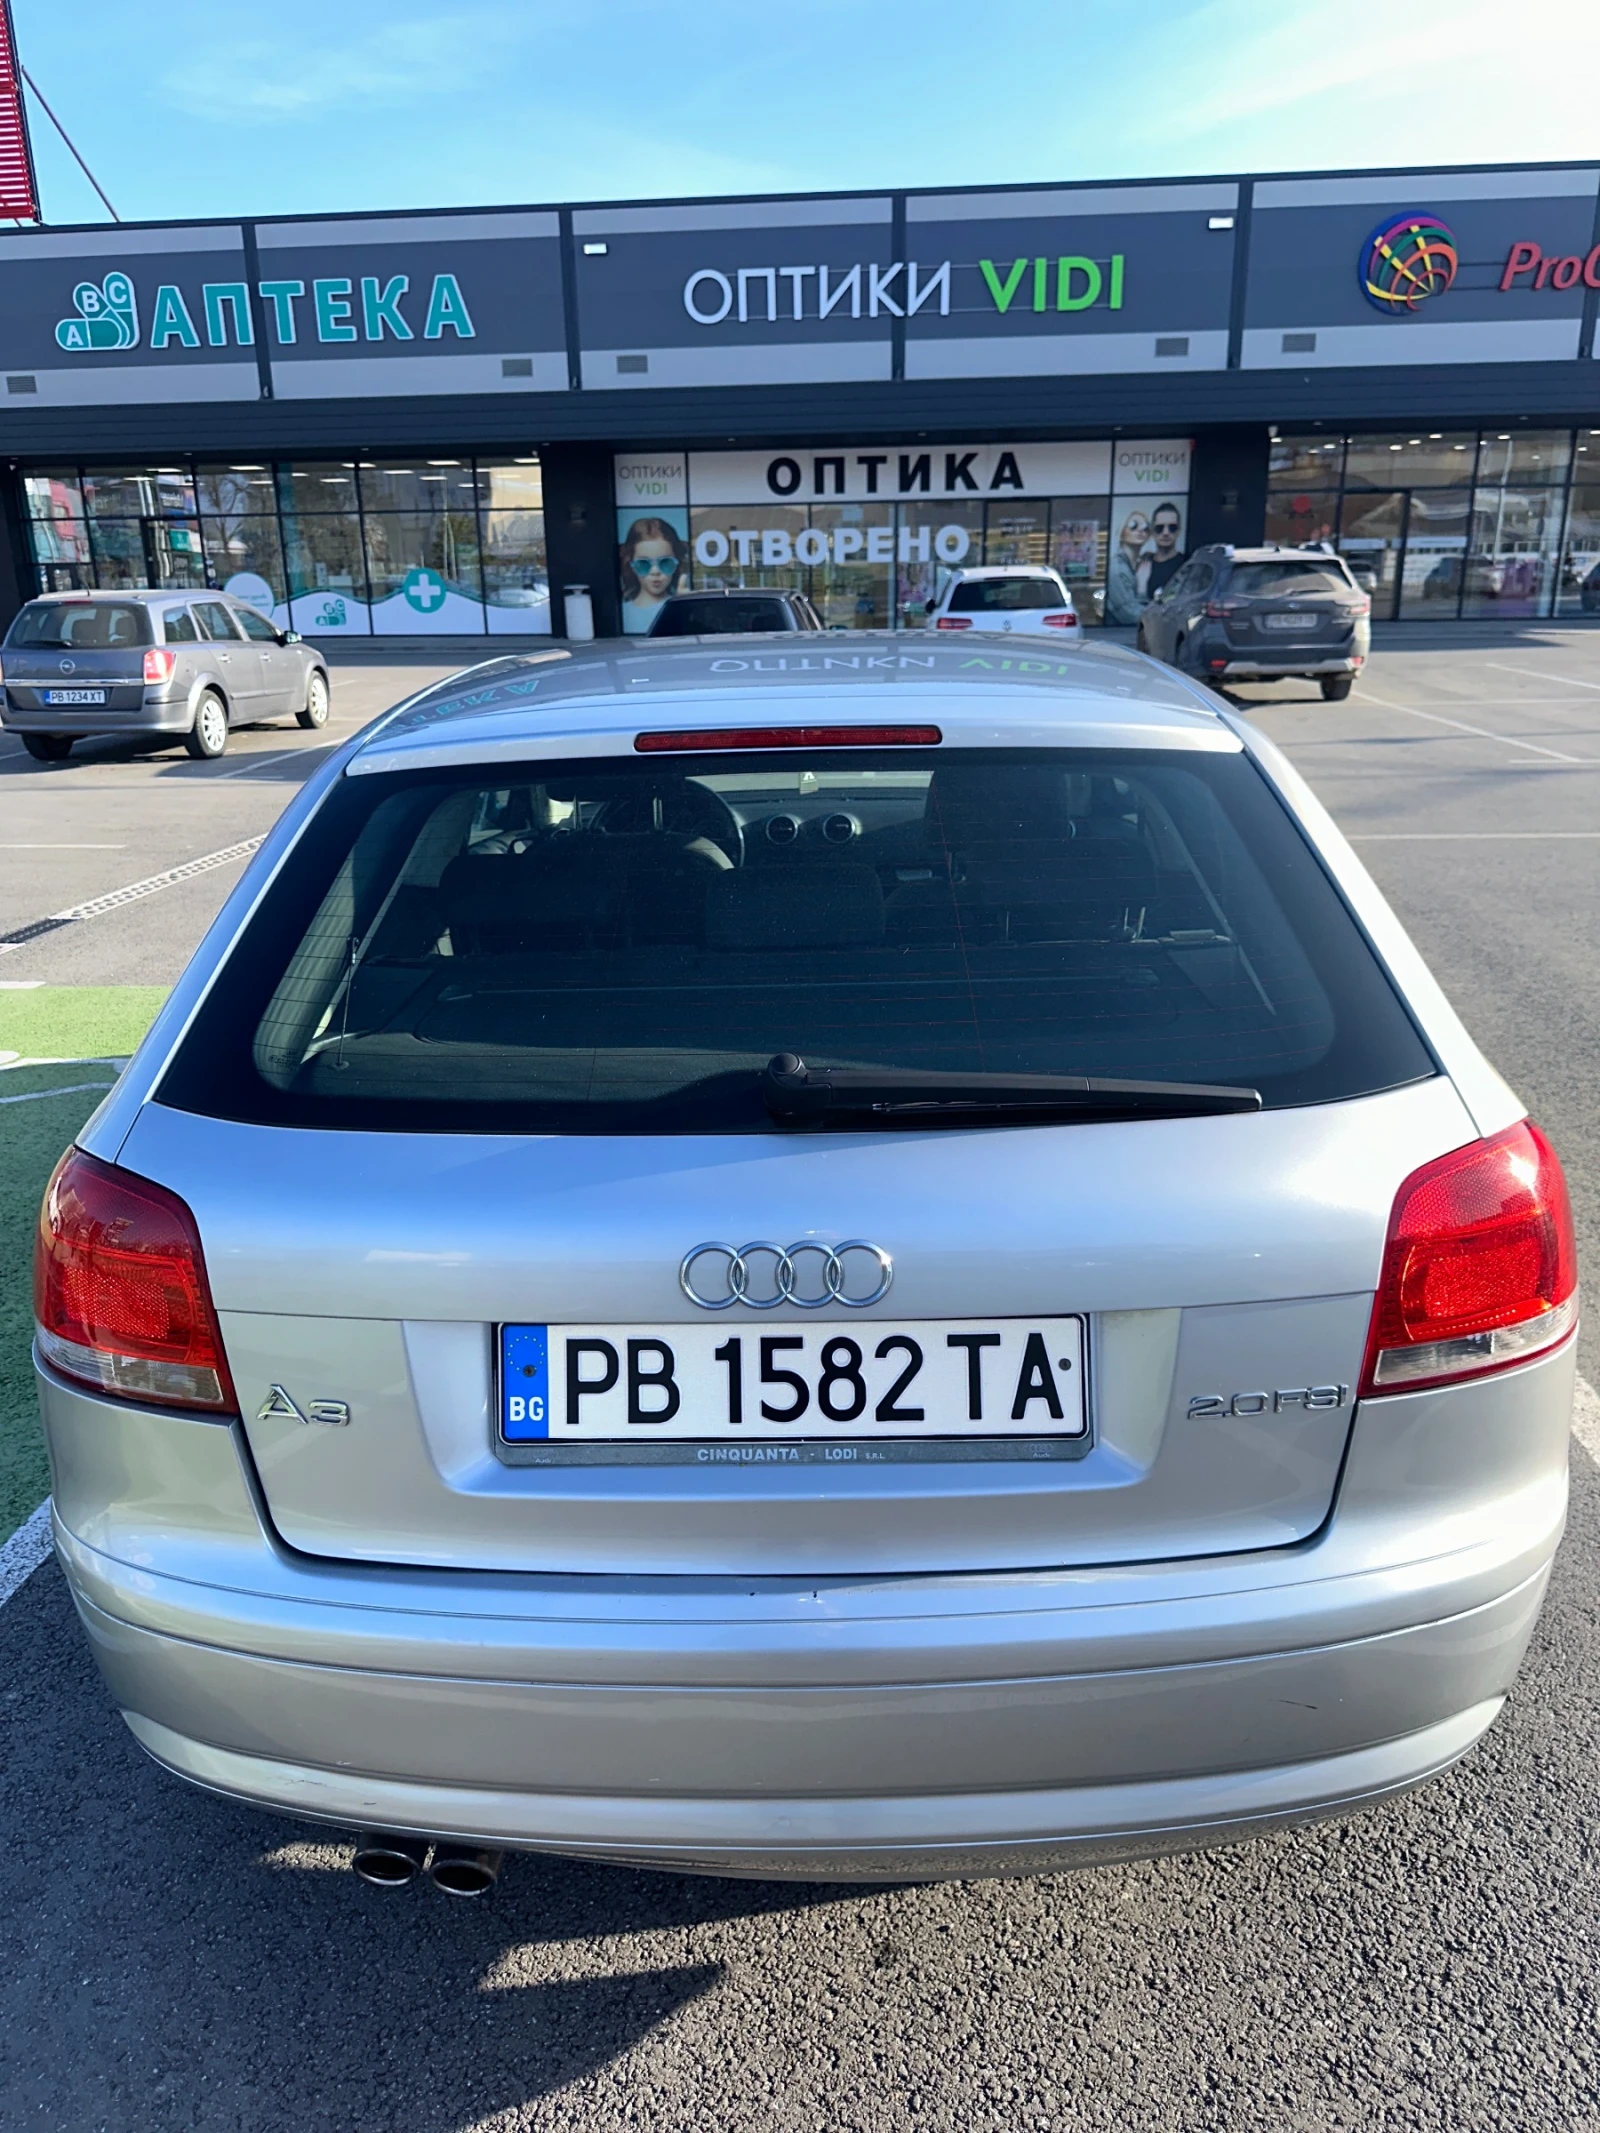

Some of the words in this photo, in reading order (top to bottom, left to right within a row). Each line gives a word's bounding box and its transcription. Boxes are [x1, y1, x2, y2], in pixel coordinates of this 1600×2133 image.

[683, 261, 951, 325] ОПТИКИ
[979, 254, 1124, 314] VIDI
[150, 273, 477, 349] АПТЕКА
[618, 464, 682, 480] ОПТИКИ
[1119, 451, 1186, 467] ОПТИКИ
[766, 451, 1025, 497] ОПТИКА
[1134, 469, 1170, 483] VIDI
[634, 482, 668, 496] VIDI
[695, 524, 971, 567] ОТВОРЕНО
[51, 691, 64, 702] PB
[66, 691, 88, 702] 1234
[90, 691, 103, 702] XT
[565, 1336, 682, 1425] PB
[714, 1334, 925, 1424] 1582
[947, 1332, 1065, 1421] TA
[256, 1383, 351, 1427] A3
[509, 1395, 545, 1422] BG
[697, 1447, 800, 1462] CINQUANTA
[824, 1447, 858, 1461] LODI
